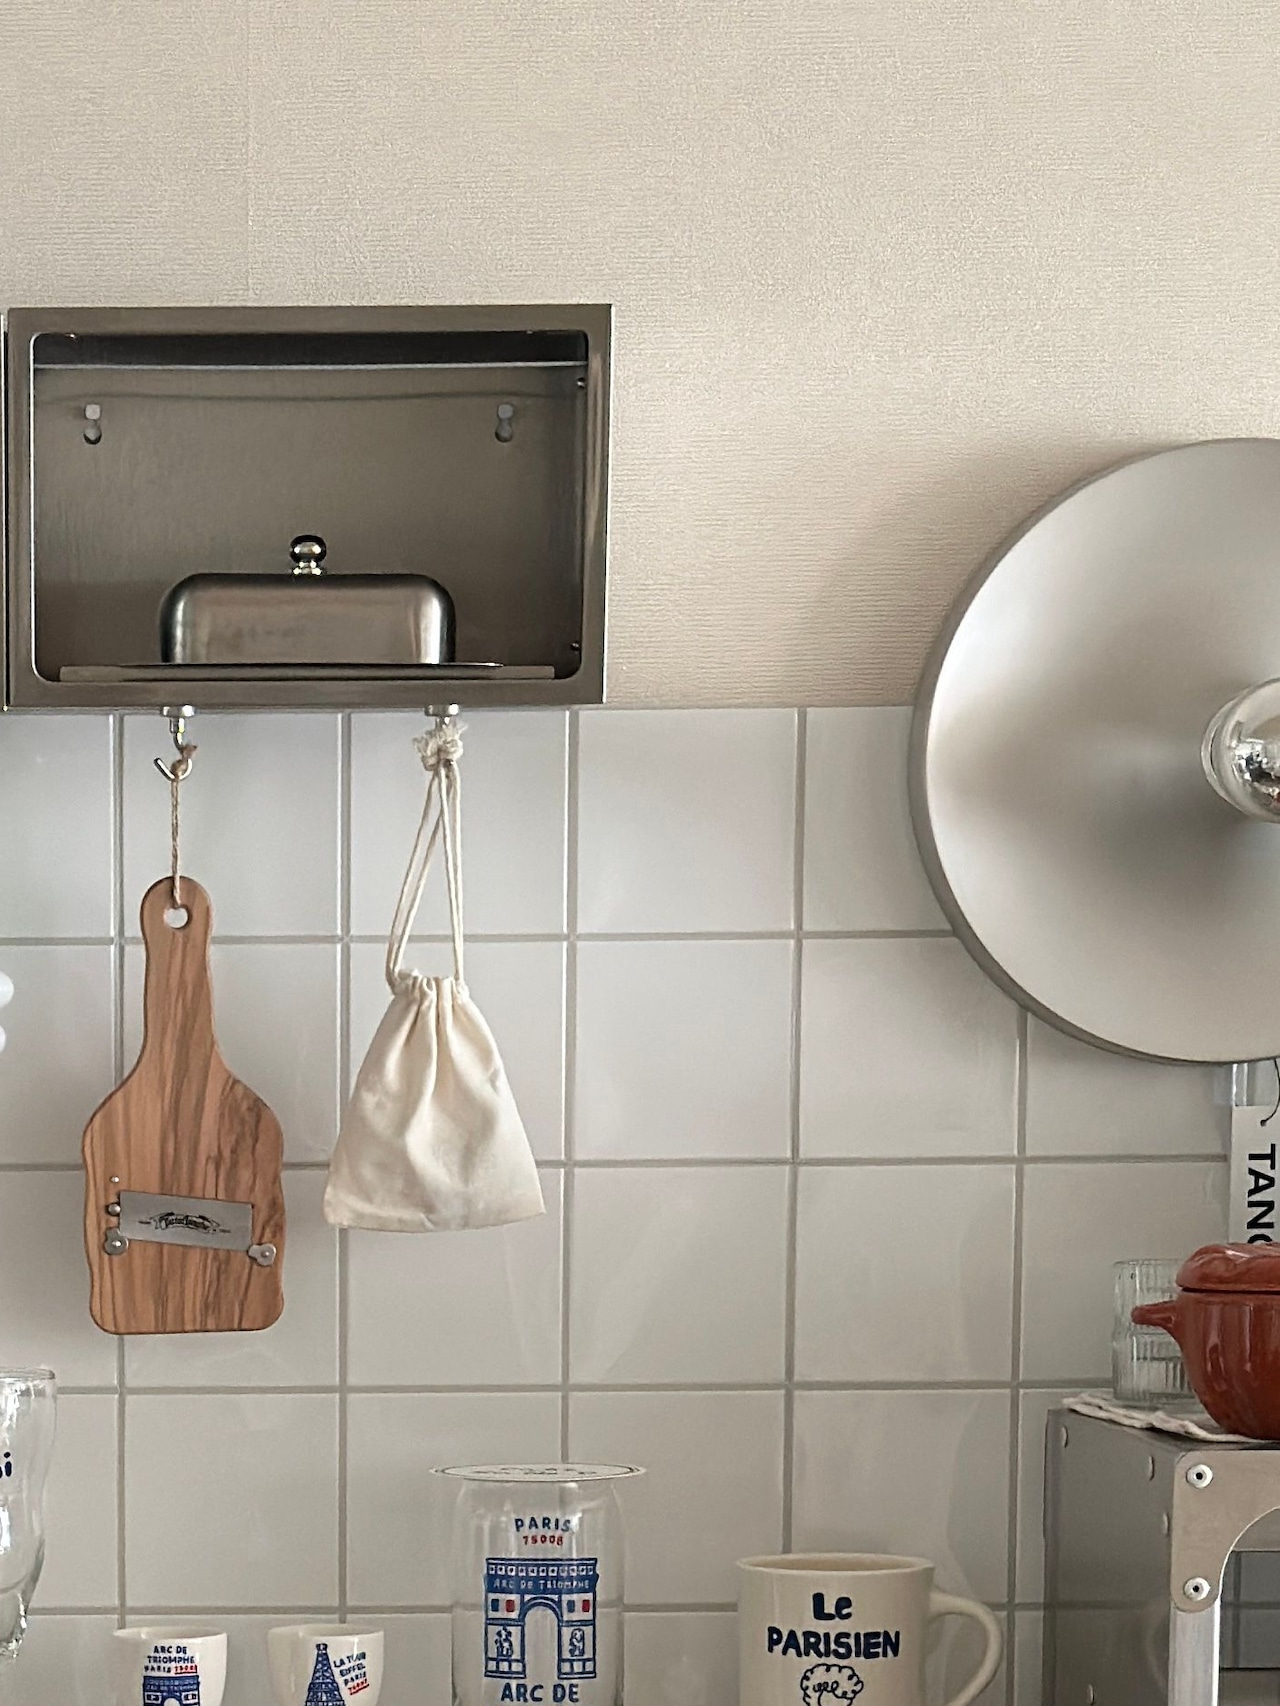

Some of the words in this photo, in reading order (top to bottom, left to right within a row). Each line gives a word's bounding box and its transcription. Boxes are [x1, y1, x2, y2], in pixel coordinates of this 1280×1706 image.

[514, 1516, 571, 1532] PARIS
[812, 1592, 852, 1620] Le
[153, 1645, 173, 1654] ARC
[176, 1645, 187, 1654] DE
[767, 1626, 900, 1660] PARISIEN
[147, 1655, 195, 1664] TRIOMPHE
[333, 1658, 346, 1668] LA
[340, 1663, 366, 1677] EIFFEL
[500, 1682, 544, 1702] ARC
[552, 1683, 580, 1703] DE
